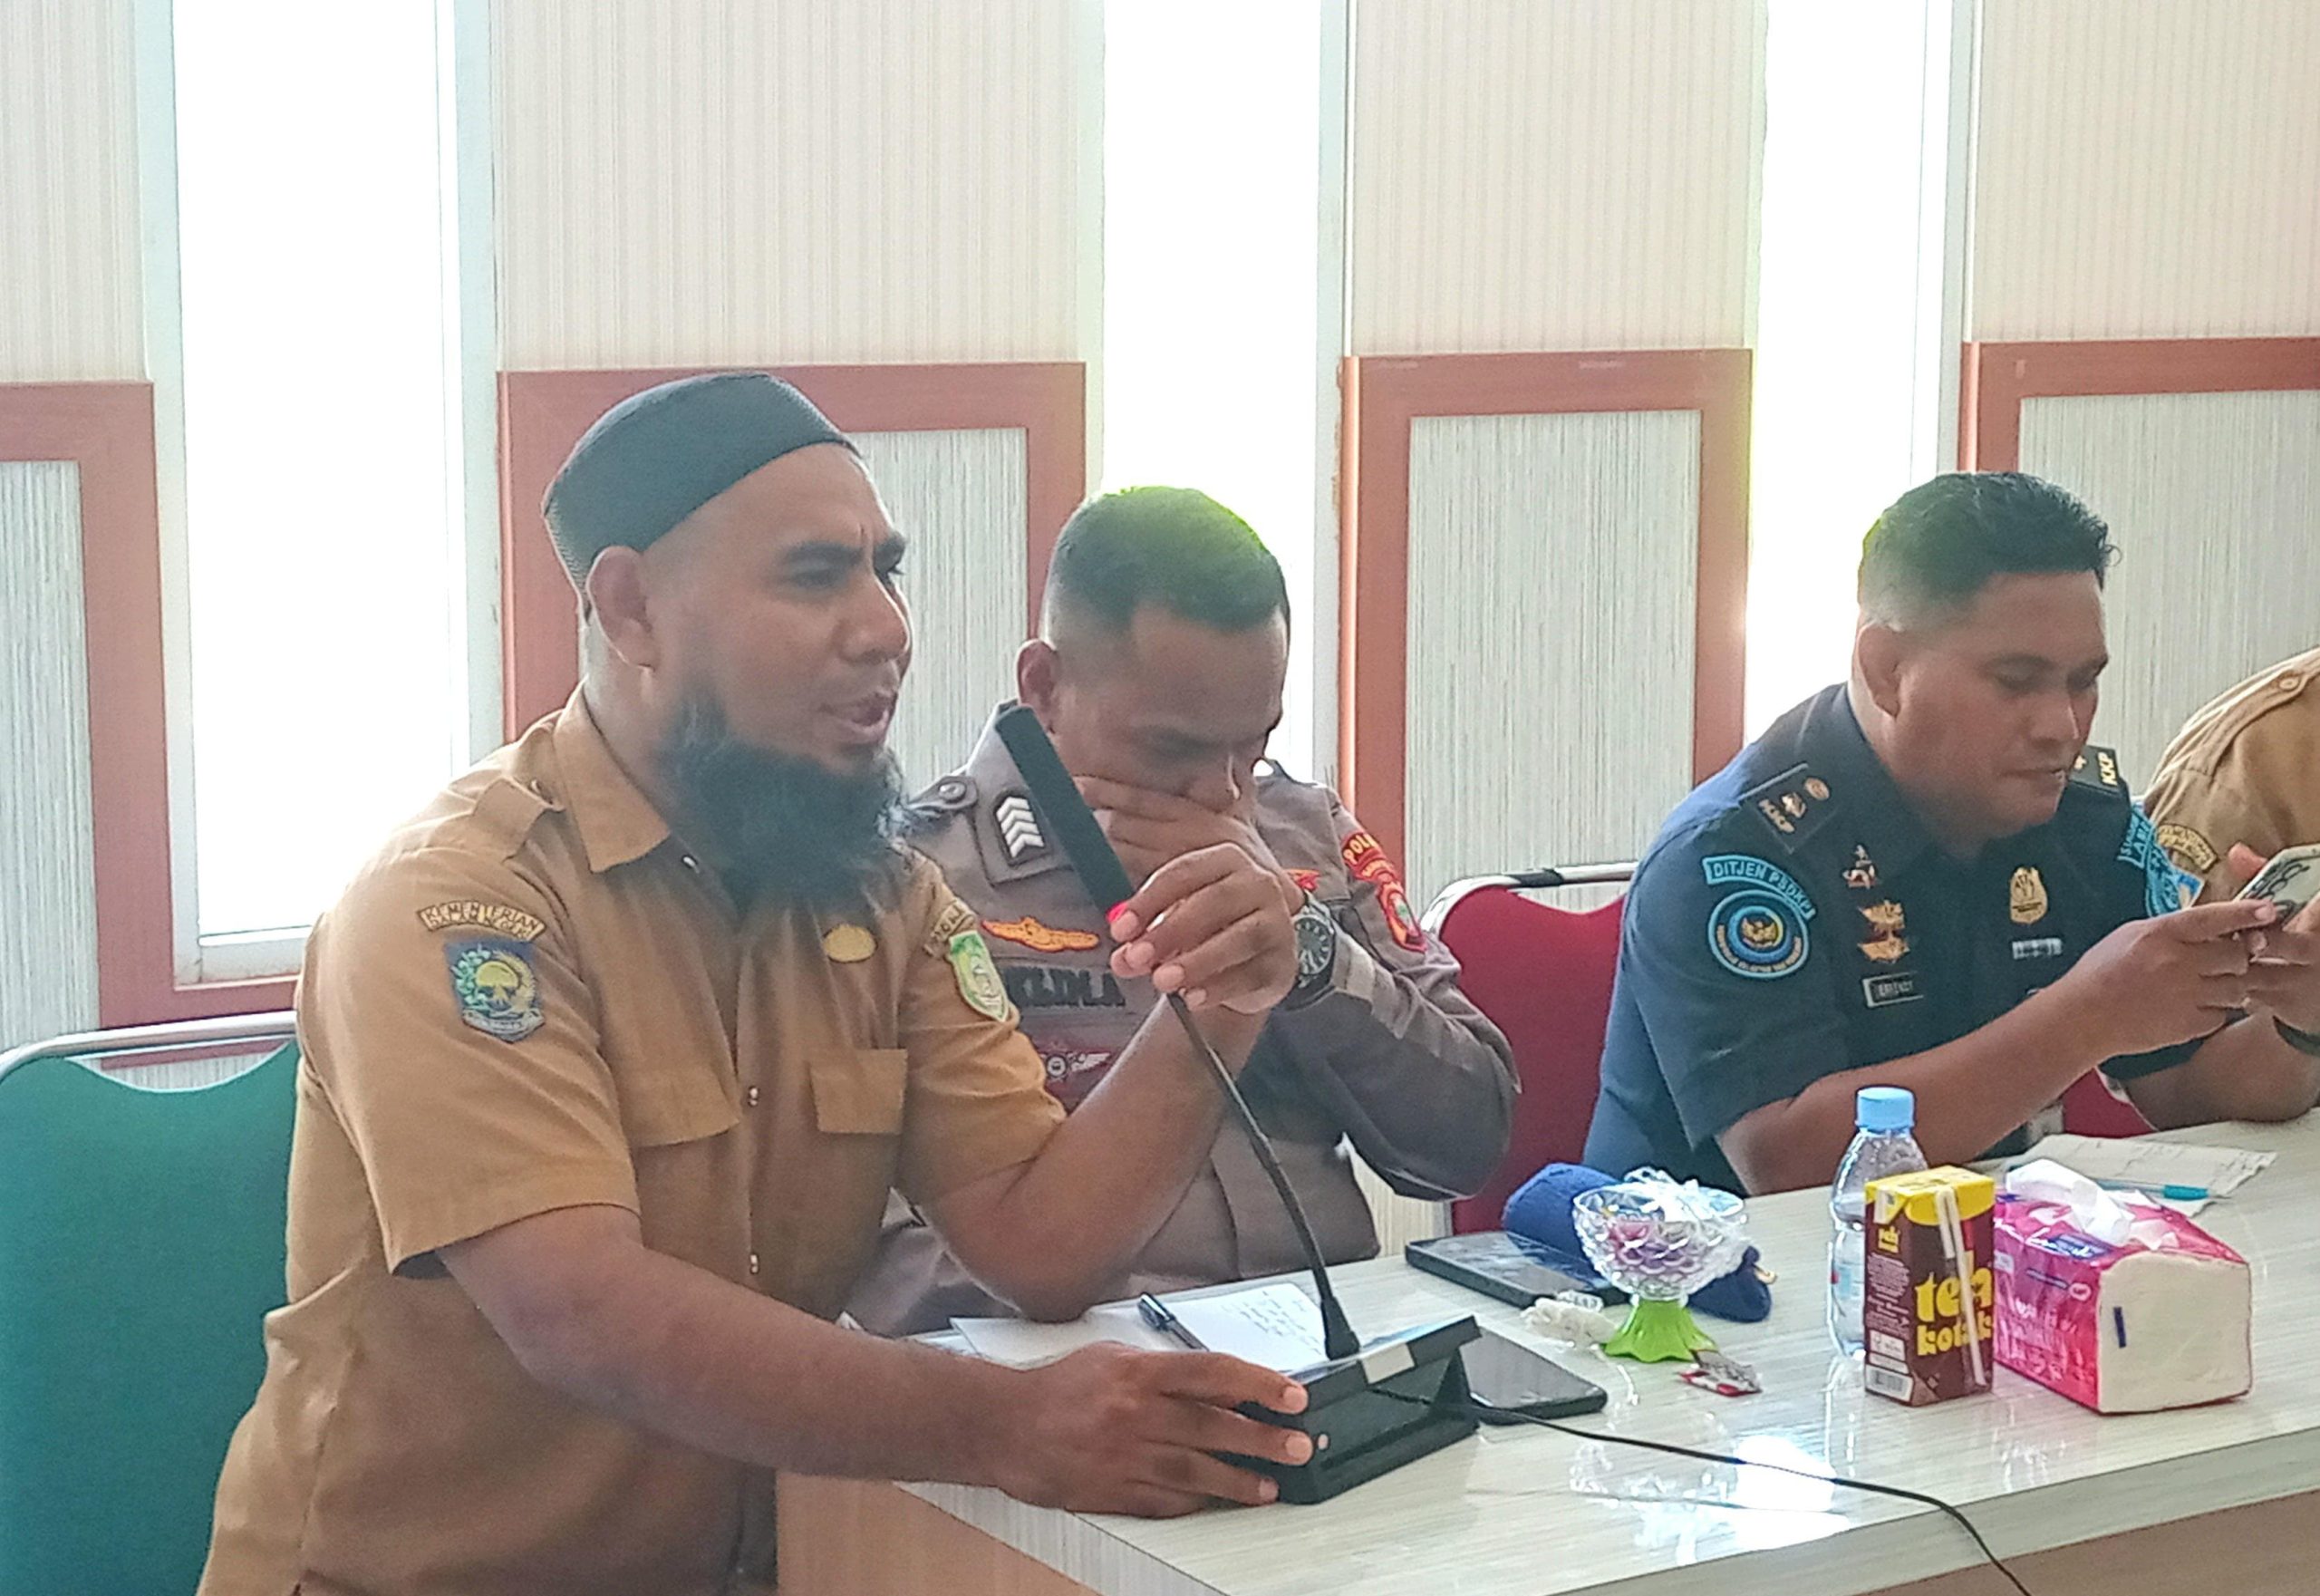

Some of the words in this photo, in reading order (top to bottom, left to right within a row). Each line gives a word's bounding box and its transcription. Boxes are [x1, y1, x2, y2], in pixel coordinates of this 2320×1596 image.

[2097, 751, 2118, 786] KKP
[1713, 861, 1767, 880] DITJEN
[1768, 869, 1812, 910] PSDKP
